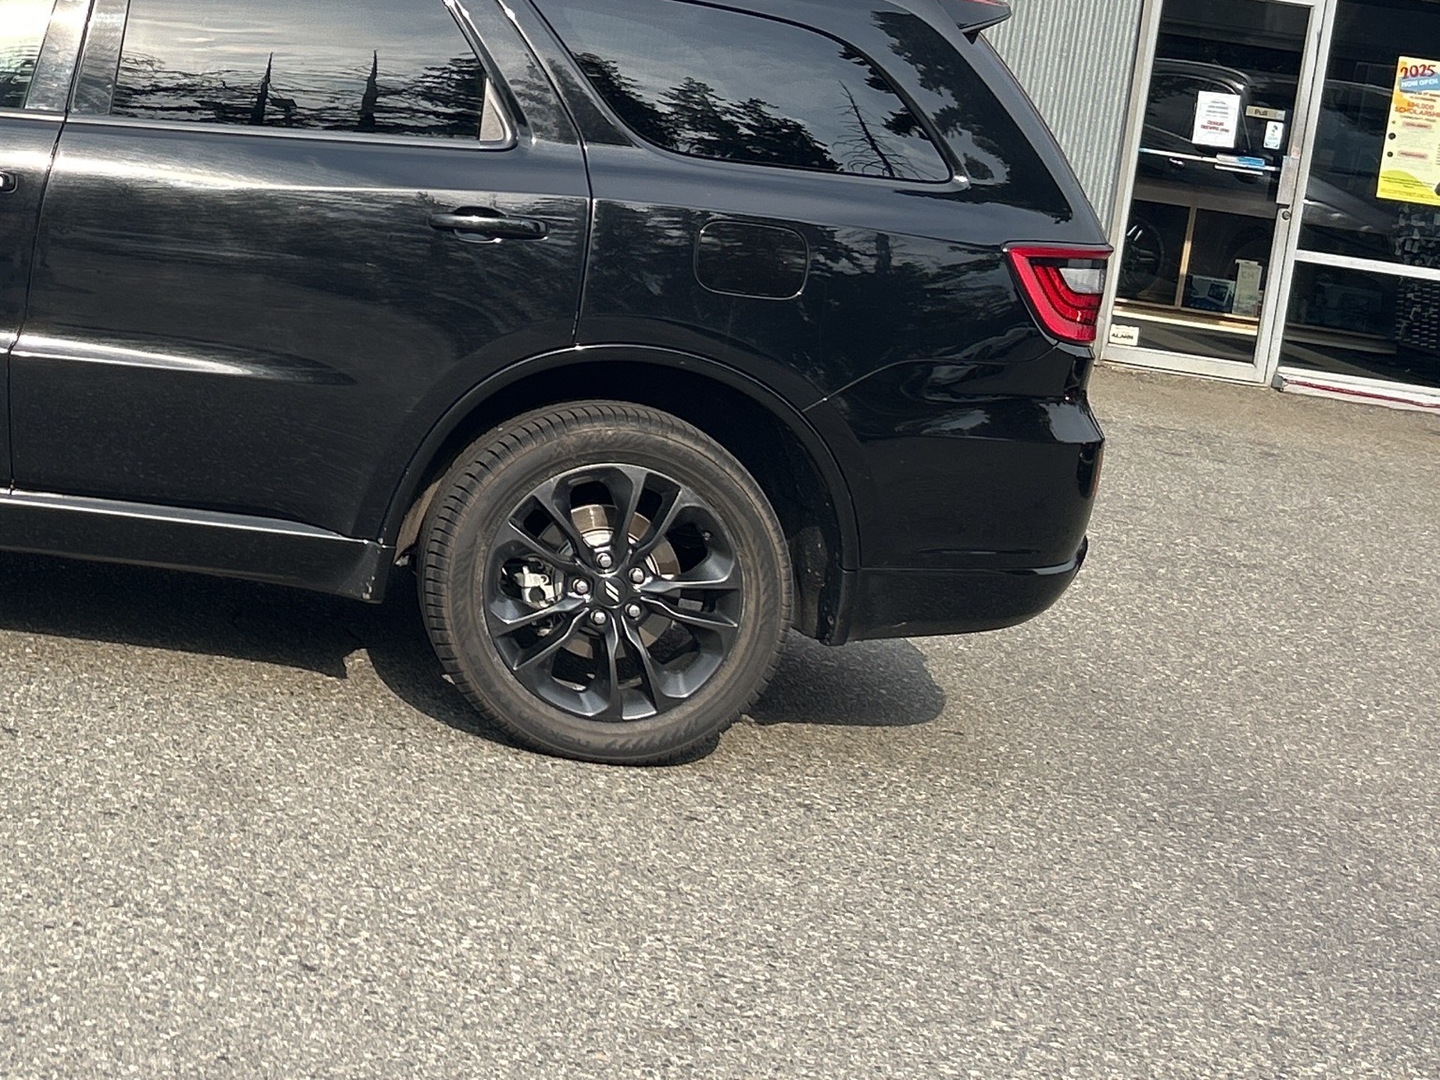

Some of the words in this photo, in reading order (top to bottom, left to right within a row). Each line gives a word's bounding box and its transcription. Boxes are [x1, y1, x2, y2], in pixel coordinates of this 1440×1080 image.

[1400, 64, 1436, 79] 2025
[1401, 80, 1418, 88] NOW
[1419, 78, 1439, 86] OPEN
